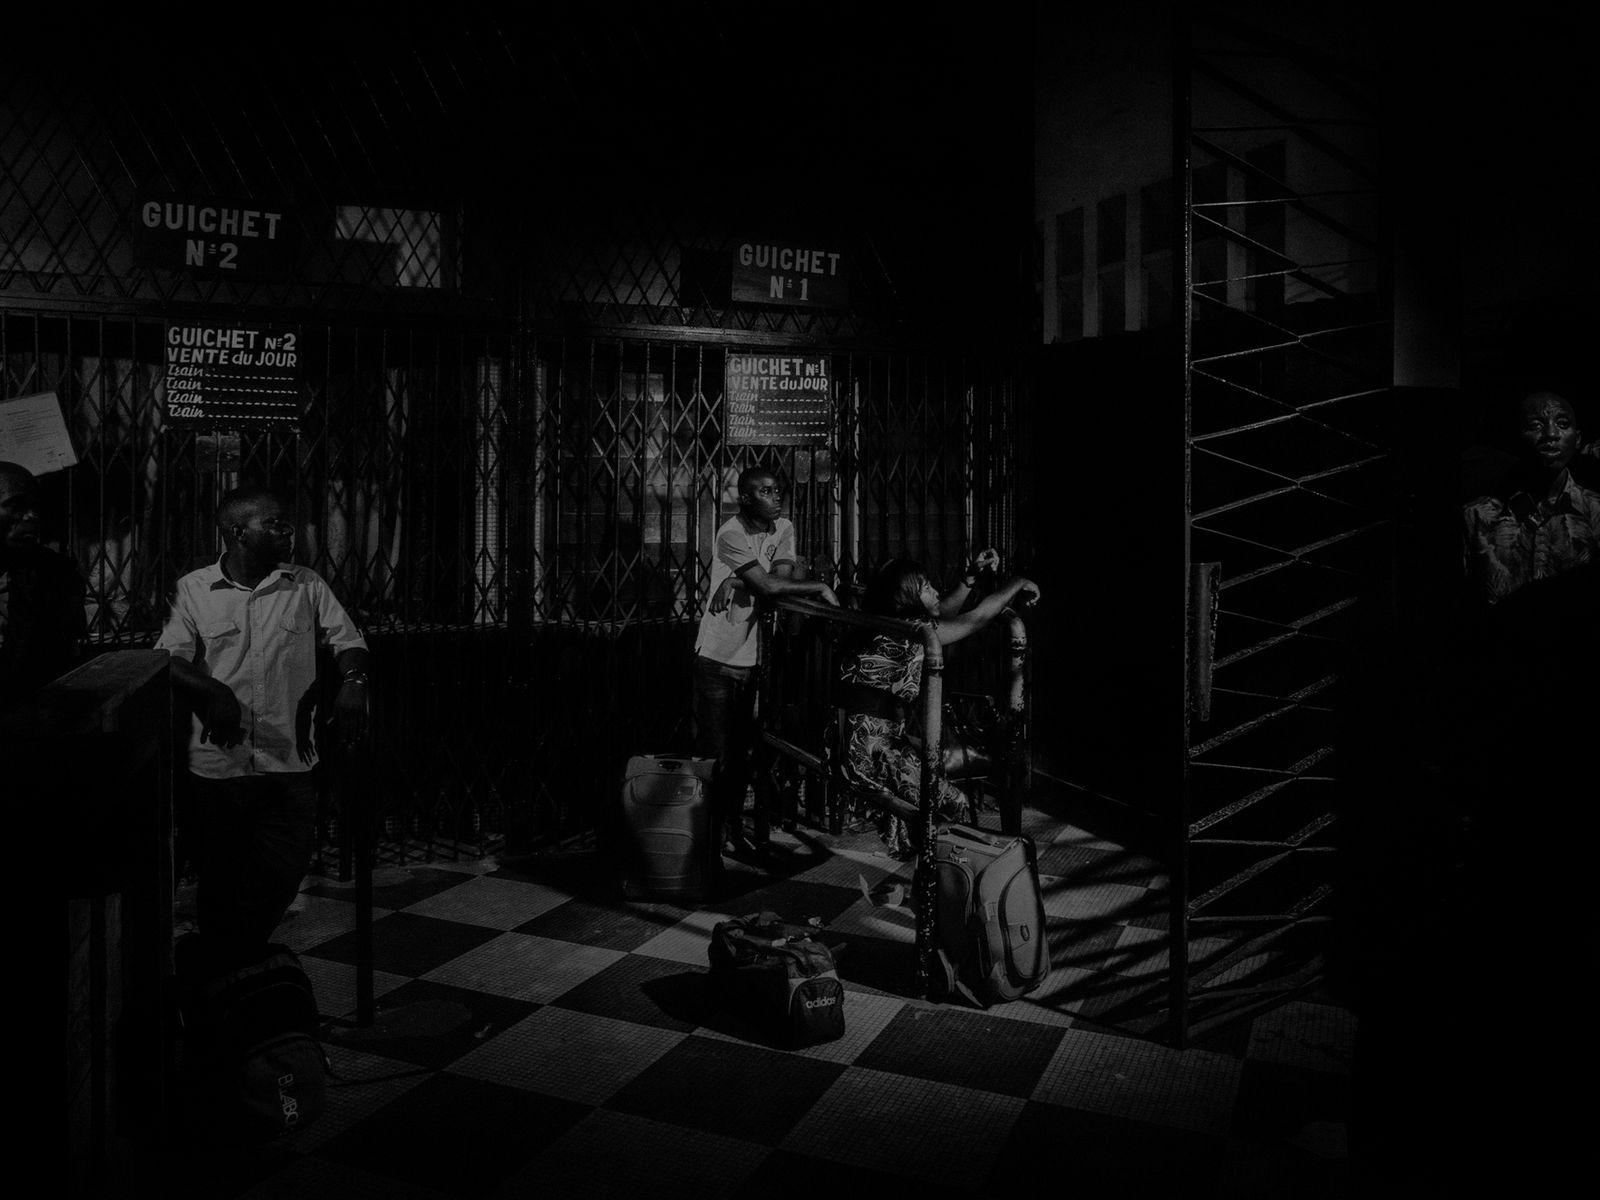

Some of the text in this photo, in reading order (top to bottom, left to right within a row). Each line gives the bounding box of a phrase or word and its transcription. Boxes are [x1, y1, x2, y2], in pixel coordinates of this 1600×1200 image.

[142, 201, 282, 240] GUICHET
[739, 243, 841, 276] GUICHET
[168, 326, 259, 349] GUICHET
[167, 347, 297, 368] VENTE du JOUR
[168, 363, 204, 377] Train
[730, 357, 804, 376] GUICHET
[166, 376, 203, 390] Train
[731, 376, 828, 391] VENTE du JOUR
[167, 390, 204, 404] Train
[168, 404, 205, 418] Train
[805, 996, 836, 1009] adidas
